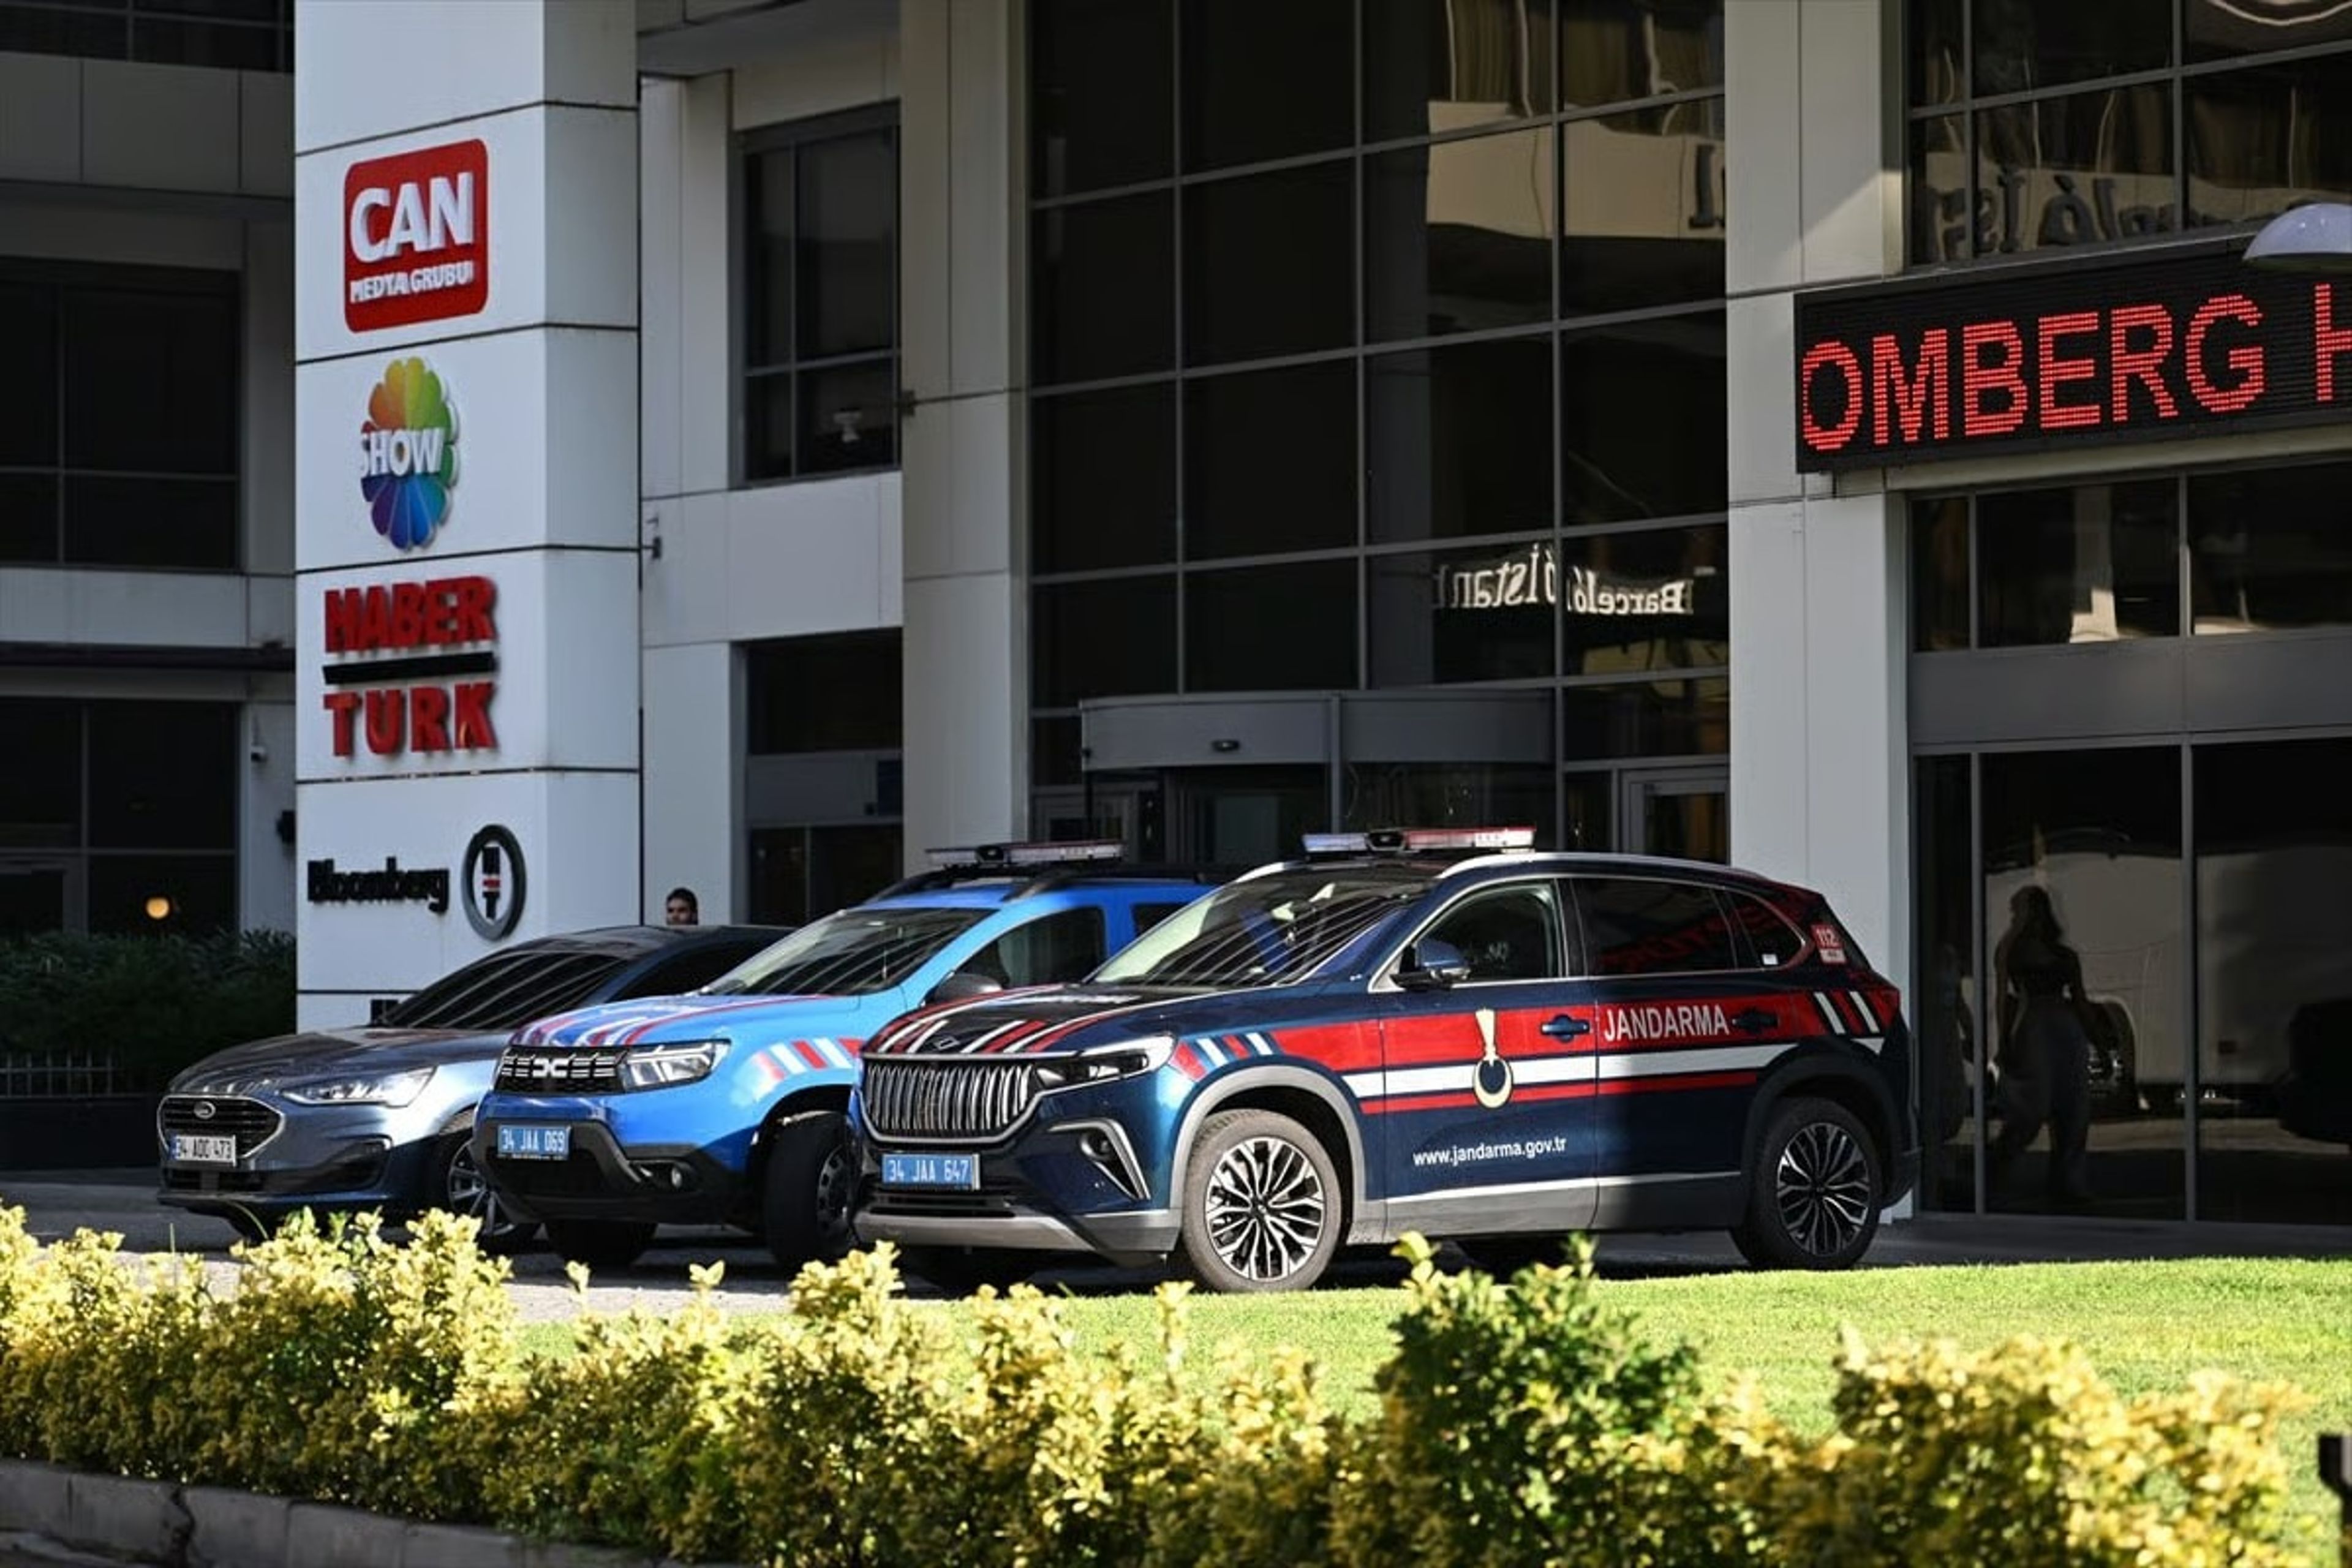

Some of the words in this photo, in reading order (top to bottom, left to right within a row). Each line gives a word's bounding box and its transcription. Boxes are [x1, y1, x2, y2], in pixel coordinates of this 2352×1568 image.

[350, 173, 473, 263] CAN
[350, 272, 410, 304] MEDYA
[410, 261, 474, 293] GRUBU
[1803, 294, 2265, 452] OMBERG
[360, 428, 445, 476] SHOW
[325, 576, 495, 654] HABER
[307, 856, 450, 913] Bloomberg
[1604, 1005, 1730, 1041] JANDARMA
[502, 1128, 514, 1150] 34
[520, 1128, 540, 1150] JAA
[1413, 1136, 1566, 1166] www.jandarma.gov.tr
[889, 1159, 905, 1182] 34
[912, 1159, 936, 1182] JAA
[944, 1159, 969, 1182] 647
